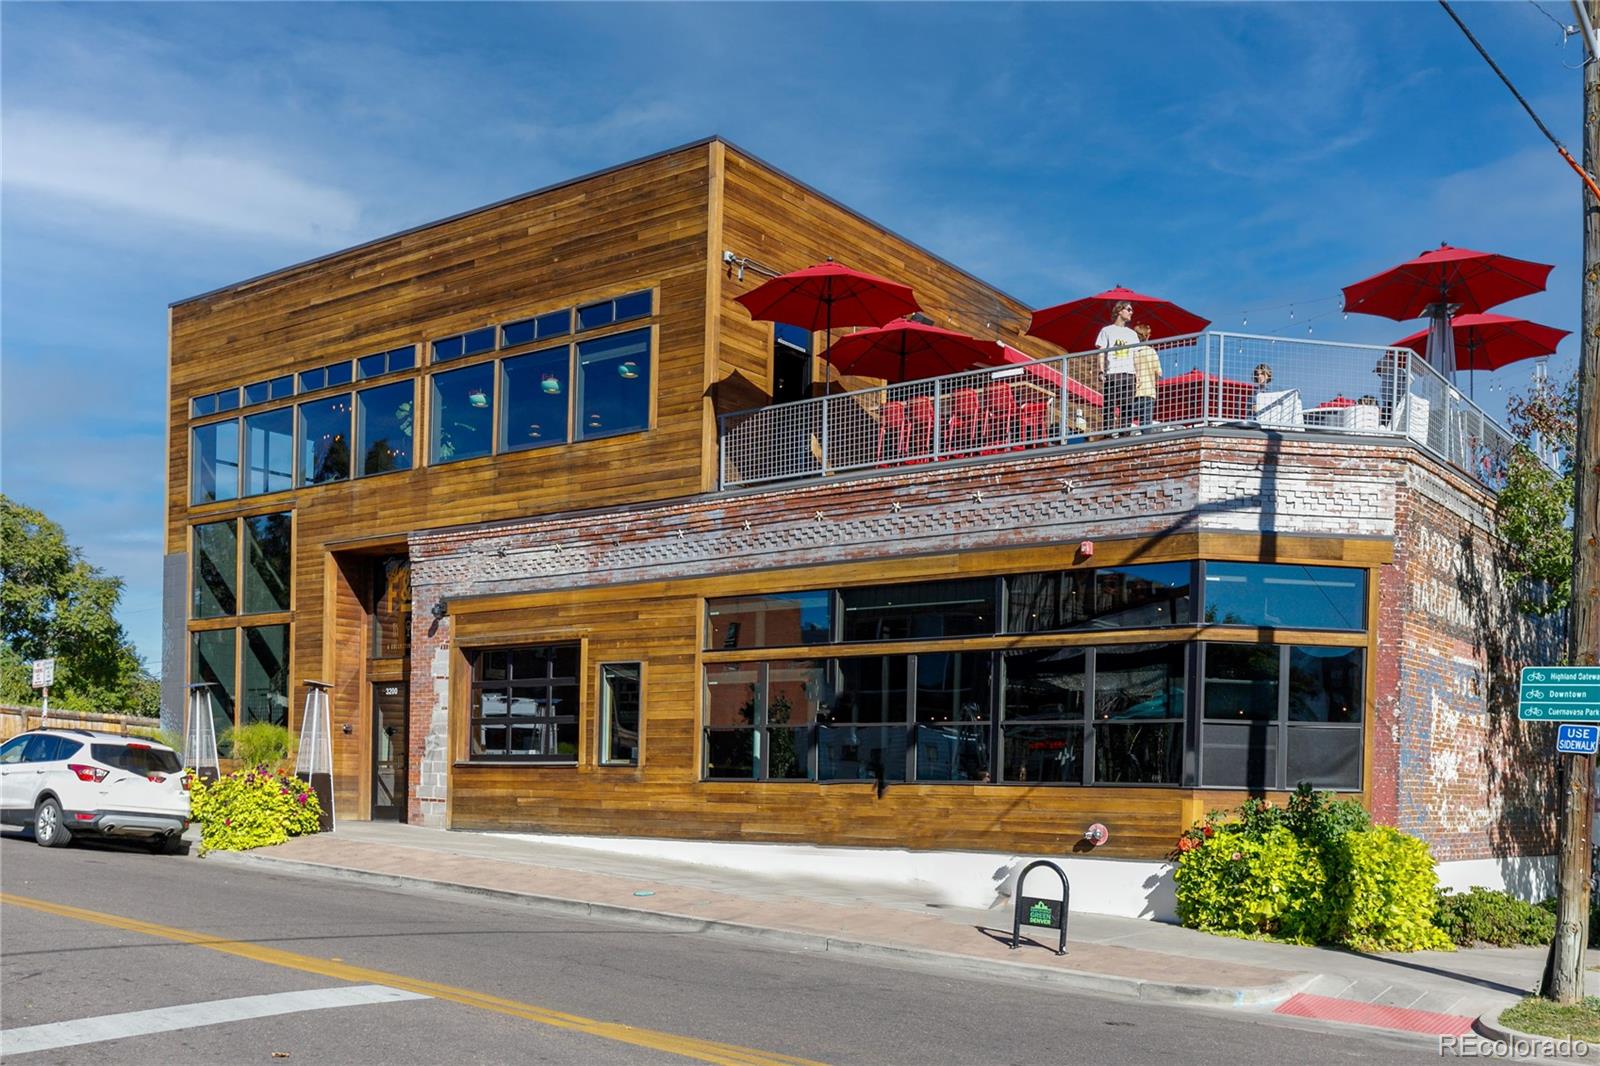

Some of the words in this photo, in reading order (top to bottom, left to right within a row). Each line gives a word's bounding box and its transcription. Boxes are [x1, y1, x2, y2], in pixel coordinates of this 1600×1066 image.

[1550, 672, 1577, 682] Highland
[1578, 672, 1600, 681] Gatewa
[1549, 690, 1587, 698] Downtown
[1584, 708, 1600, 716] Park
[1567, 728, 1590, 739] USE
[1559, 739, 1596, 750] SIDEWALK
[1030, 911, 1051, 920] GREEN
